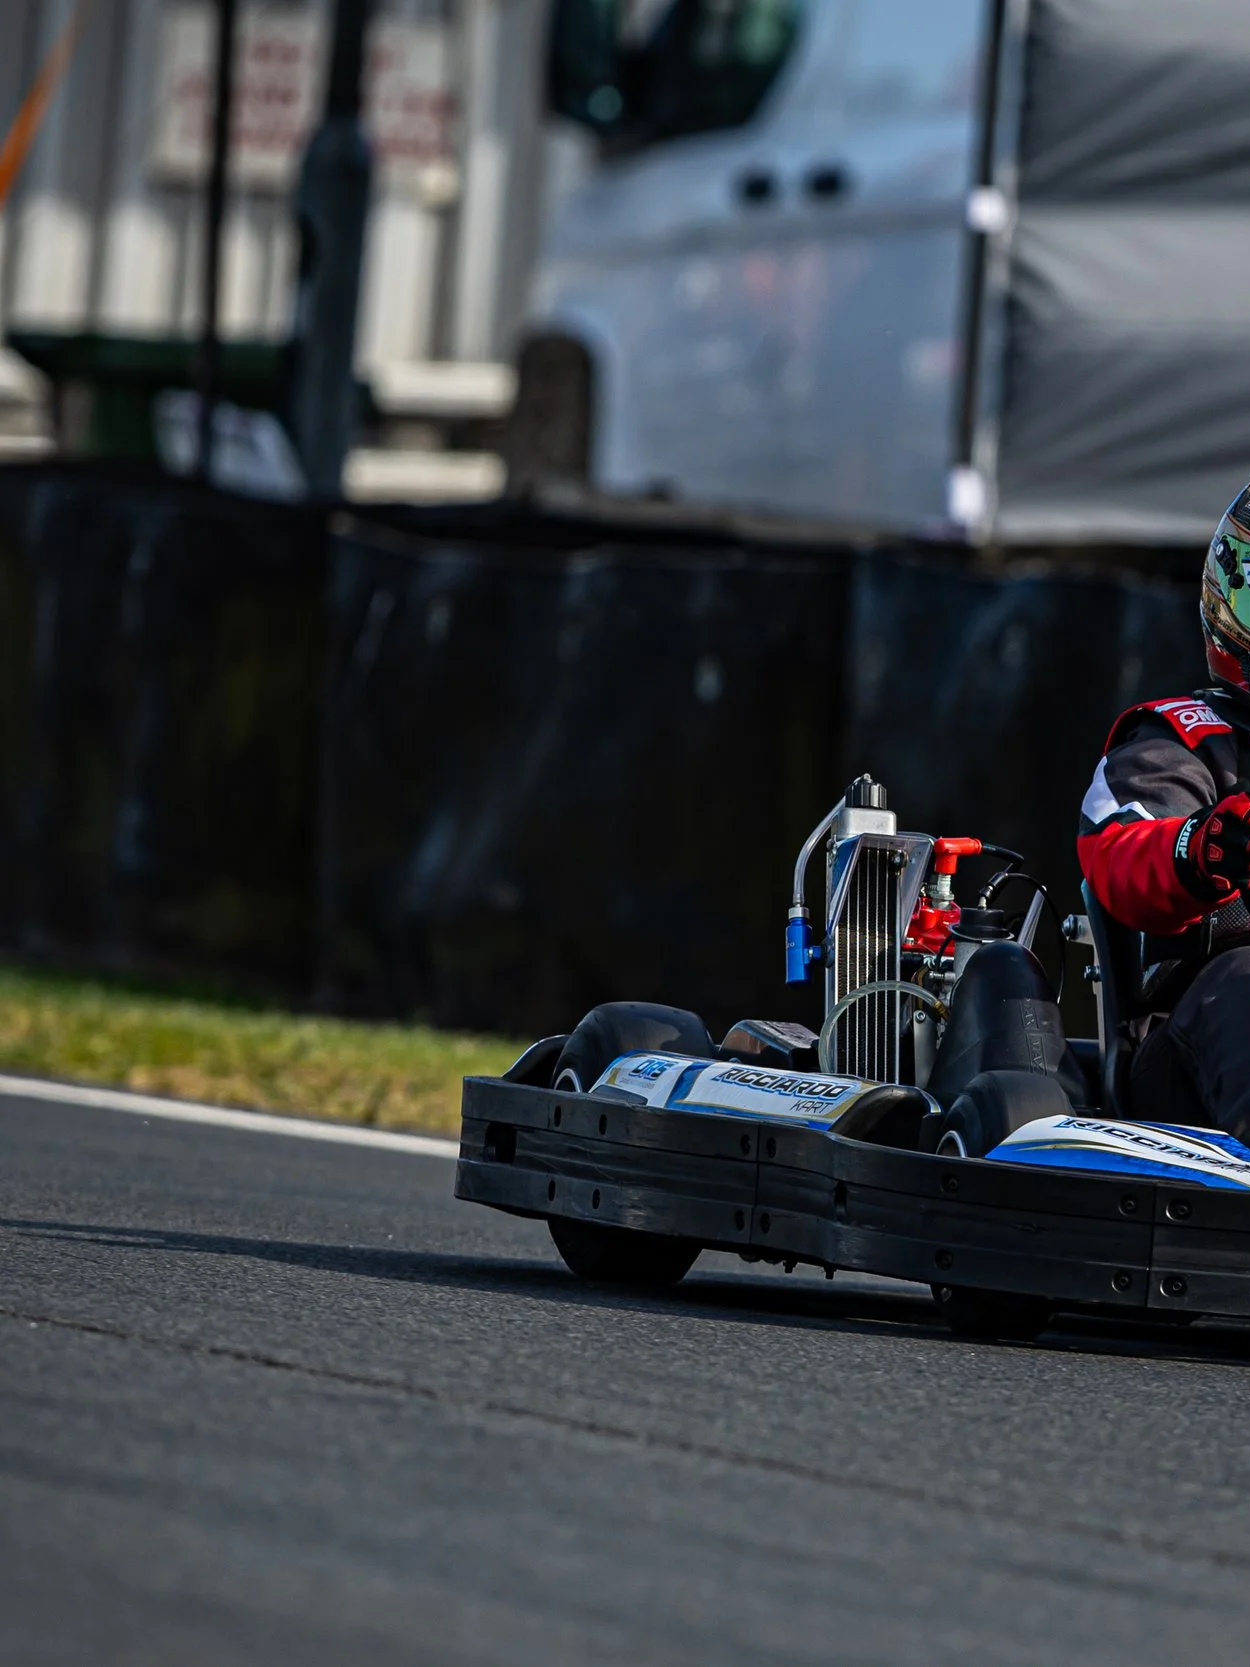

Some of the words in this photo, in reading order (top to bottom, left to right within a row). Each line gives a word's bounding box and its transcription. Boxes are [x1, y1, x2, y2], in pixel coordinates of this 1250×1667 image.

[630, 1059, 675, 1080] DRS
[714, 1068, 855, 1099] RICCIARDO
[790, 1099, 834, 1114] KART
